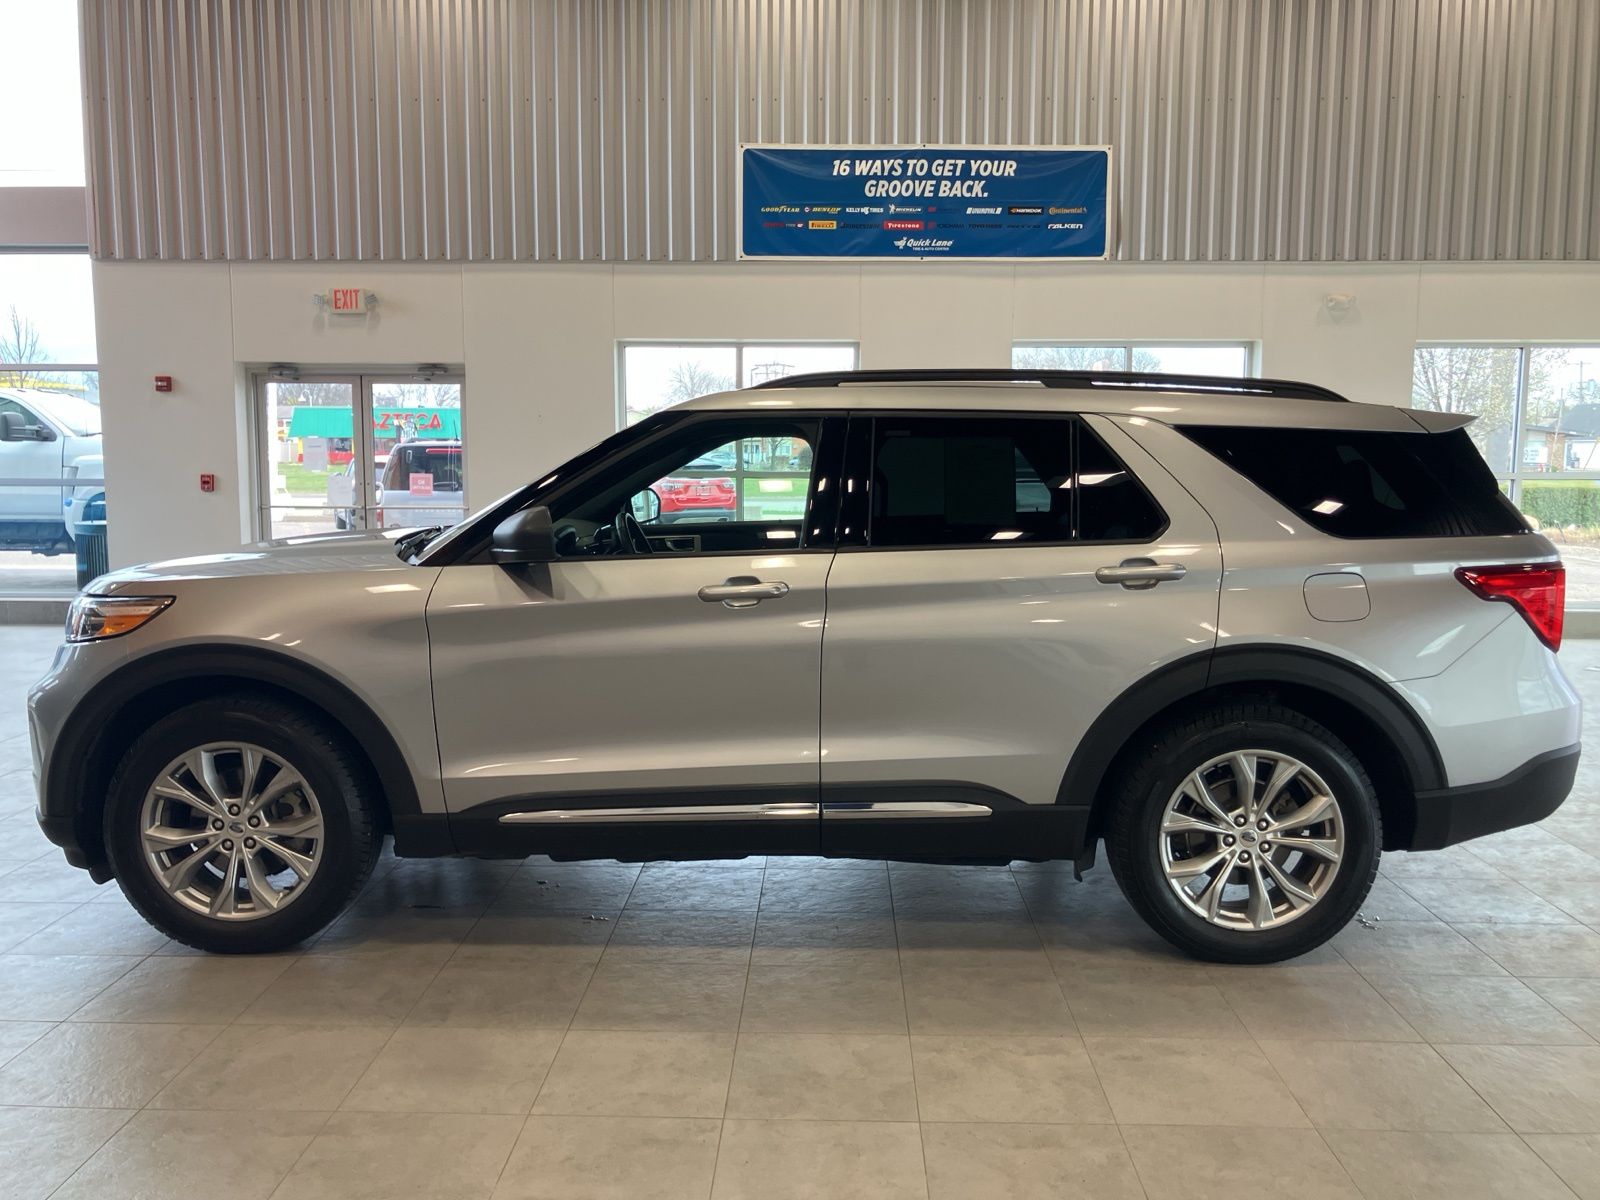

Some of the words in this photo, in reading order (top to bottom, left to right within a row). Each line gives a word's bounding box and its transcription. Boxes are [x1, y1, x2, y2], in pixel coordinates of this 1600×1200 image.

[832, 159, 851, 176] 16
[855, 159, 903, 176] WAYS
[906, 159, 929, 176] TO
[931, 159, 965, 176] GET
[969, 159, 1017, 177] YOUR
[864, 180, 936, 197] GROOVE
[938, 180, 989, 198] BACK.
[906, 239, 931, 247] Quick
[931, 239, 953, 247] Lane
[333, 287, 360, 310] EXIT
